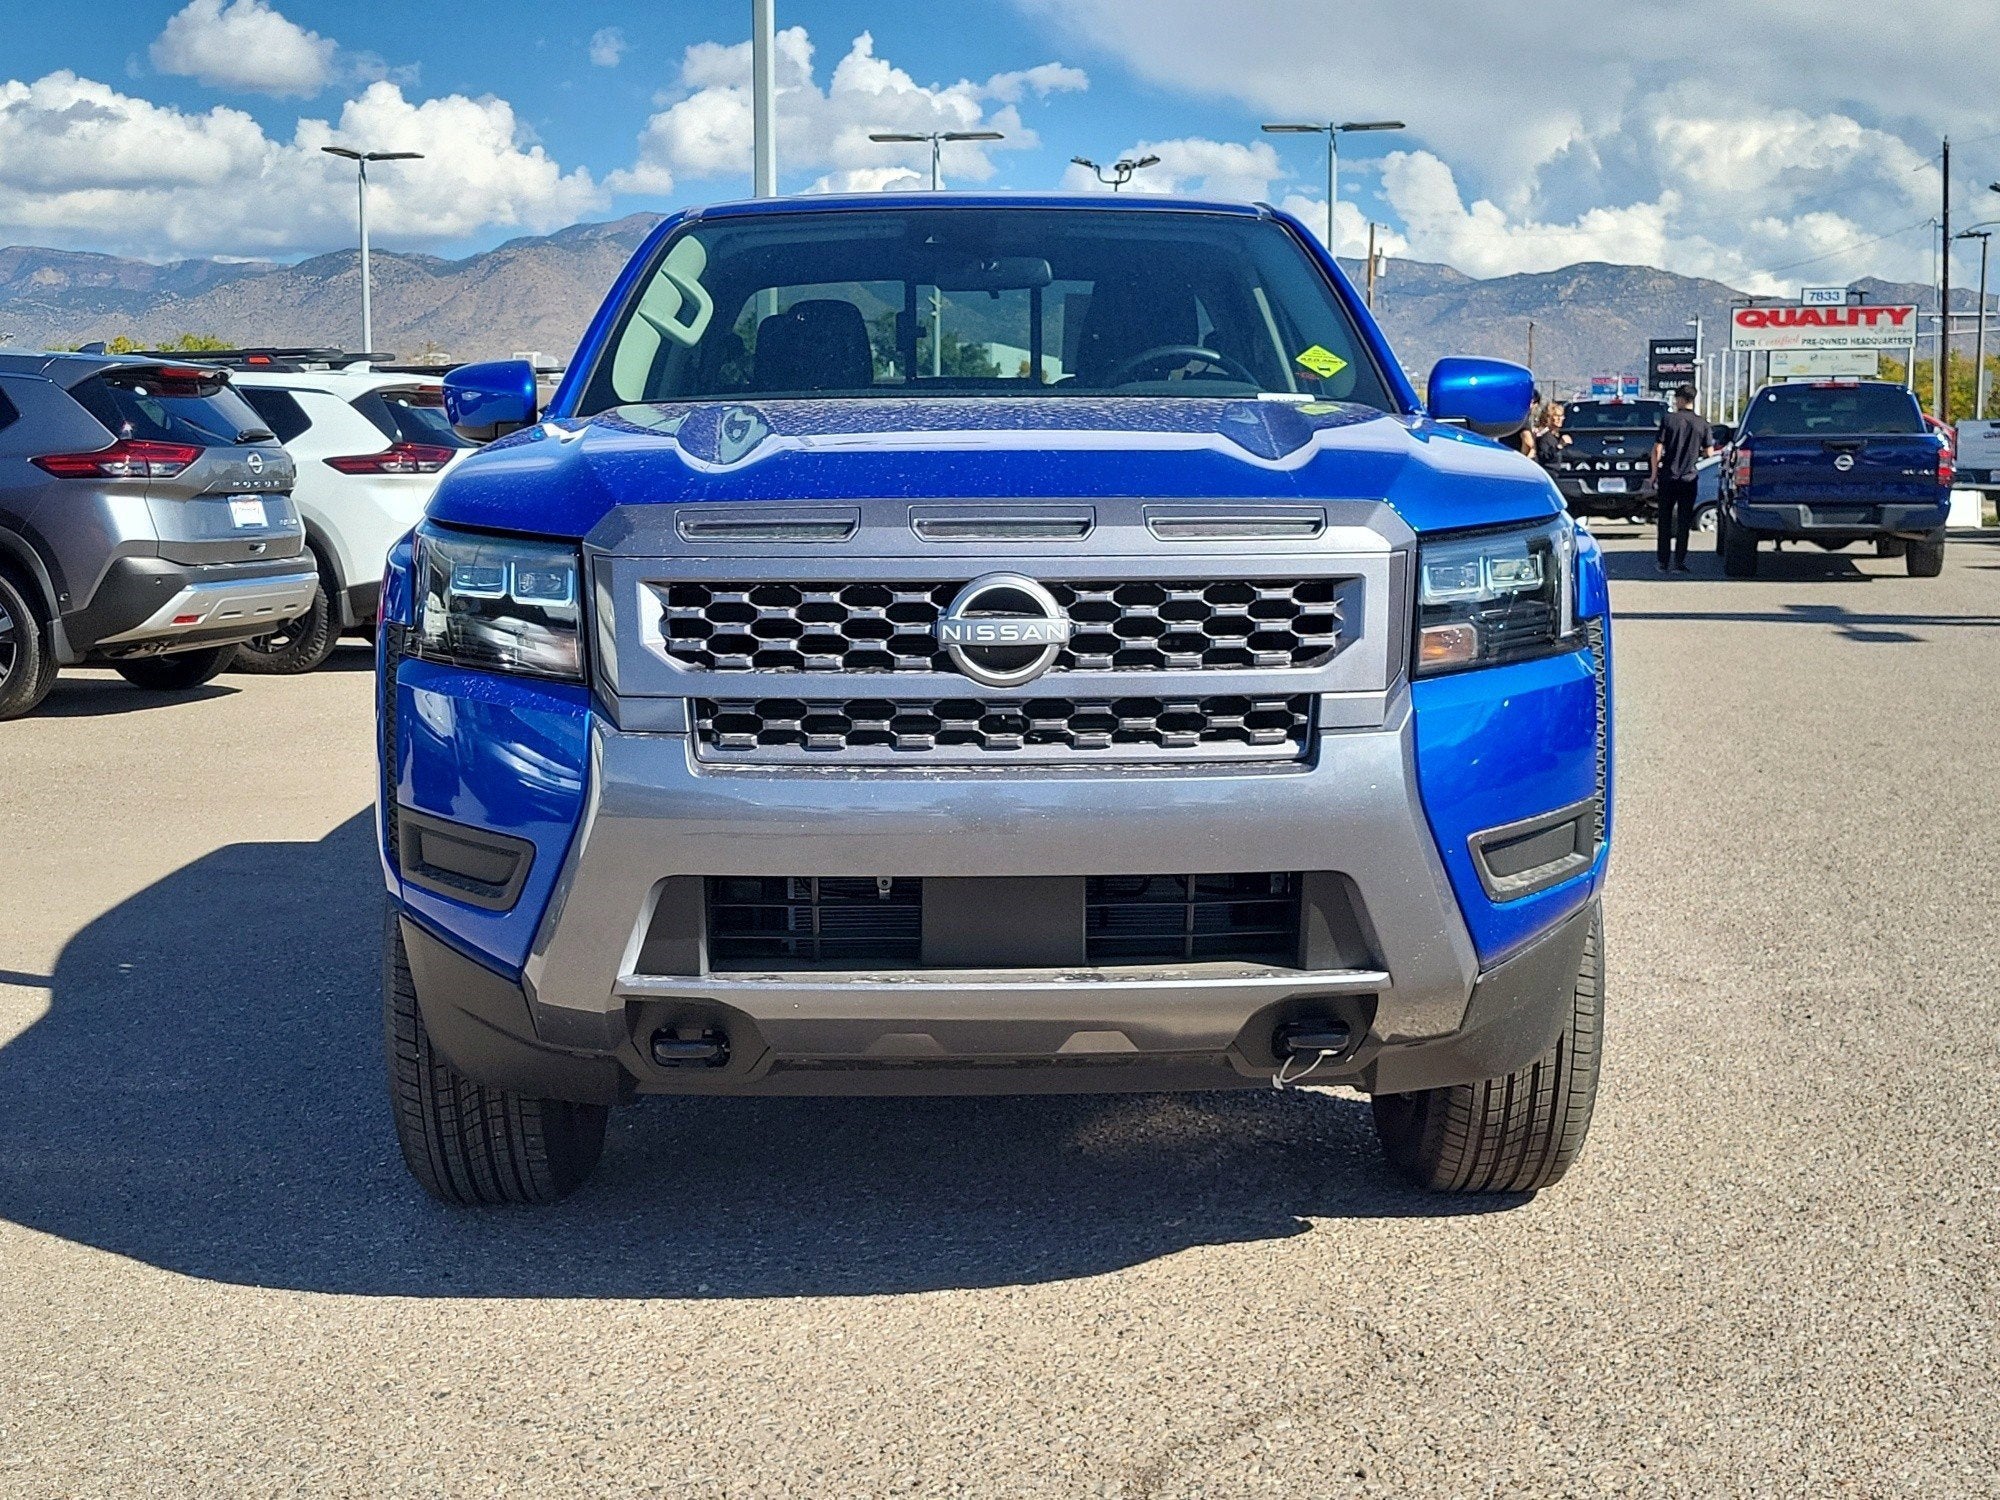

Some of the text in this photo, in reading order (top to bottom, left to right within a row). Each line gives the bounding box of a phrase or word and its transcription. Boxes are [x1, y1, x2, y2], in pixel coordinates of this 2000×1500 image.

[1809, 291, 1840, 302] 7833
[1735, 307, 1914, 328] QUALITY
[1735, 339, 1756, 347] YOUR
[1801, 337, 1848, 346] PRE-OWNED
[1850, 337, 1914, 346] HEADQUARTERS
[1560, 462, 1663, 471] RANGE
[942, 624, 1066, 641] NISSAN
